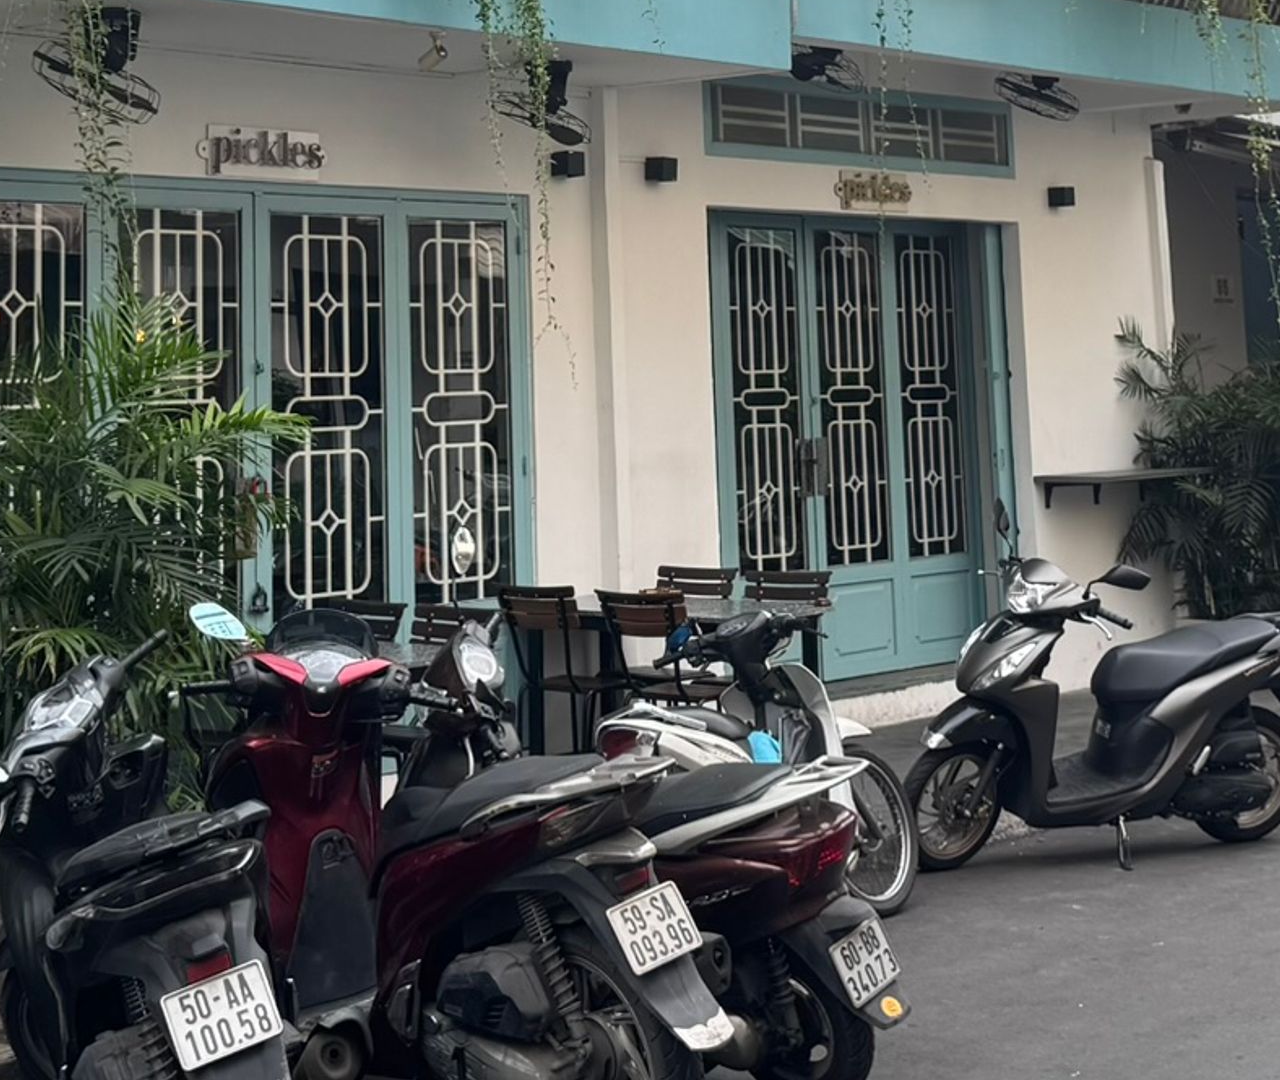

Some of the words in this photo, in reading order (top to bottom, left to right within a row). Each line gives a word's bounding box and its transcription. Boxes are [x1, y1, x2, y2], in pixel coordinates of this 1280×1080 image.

[209, 128, 324, 175] pickles
[620, 892, 676, 935] 59-SA
[630, 918, 694, 967] 093.96
[840, 925, 881, 971] 60-B8
[178, 972, 255, 1025] 50-AA
[847, 948, 897, 1001] 340.73
[185, 1003, 272, 1061] 100.58
